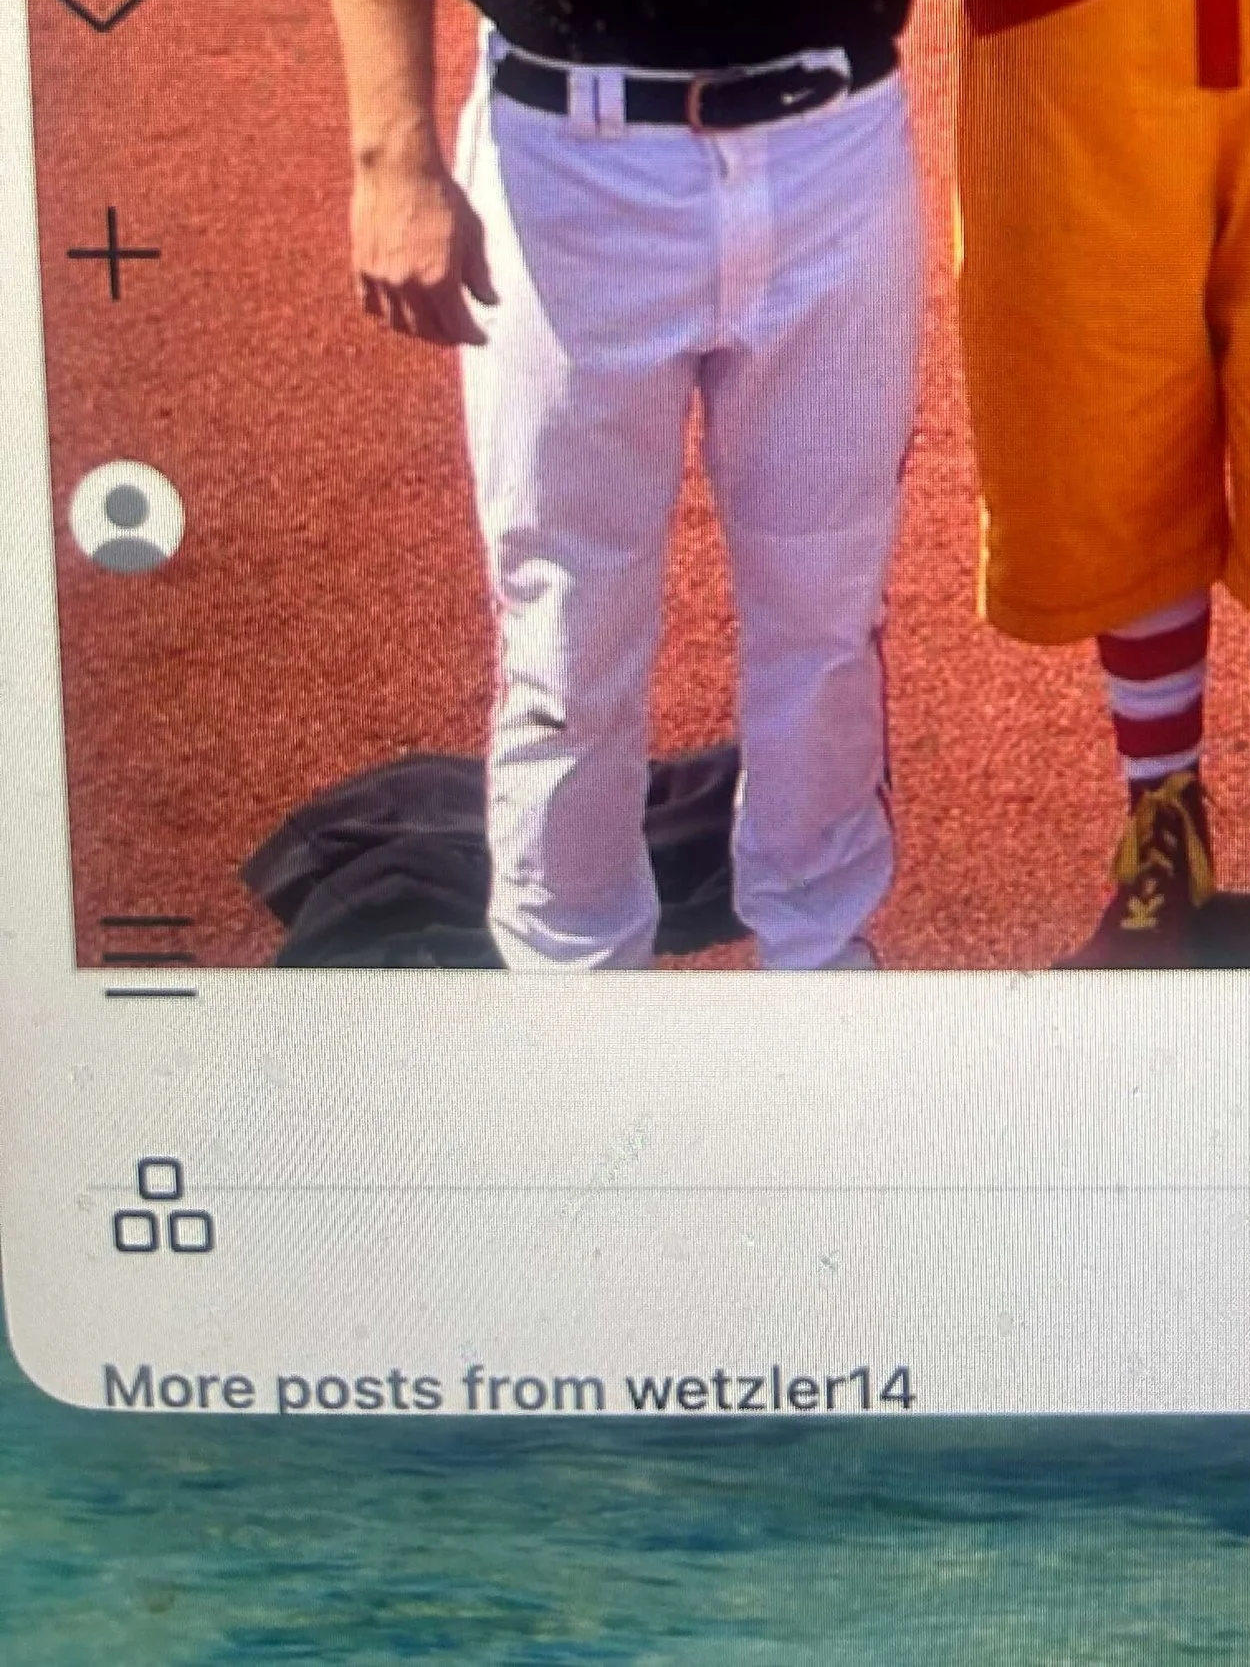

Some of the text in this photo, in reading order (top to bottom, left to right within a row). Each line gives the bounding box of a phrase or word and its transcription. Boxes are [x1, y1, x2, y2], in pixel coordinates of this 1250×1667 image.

[103, 1363, 918, 1414] More posts from wetzler14
